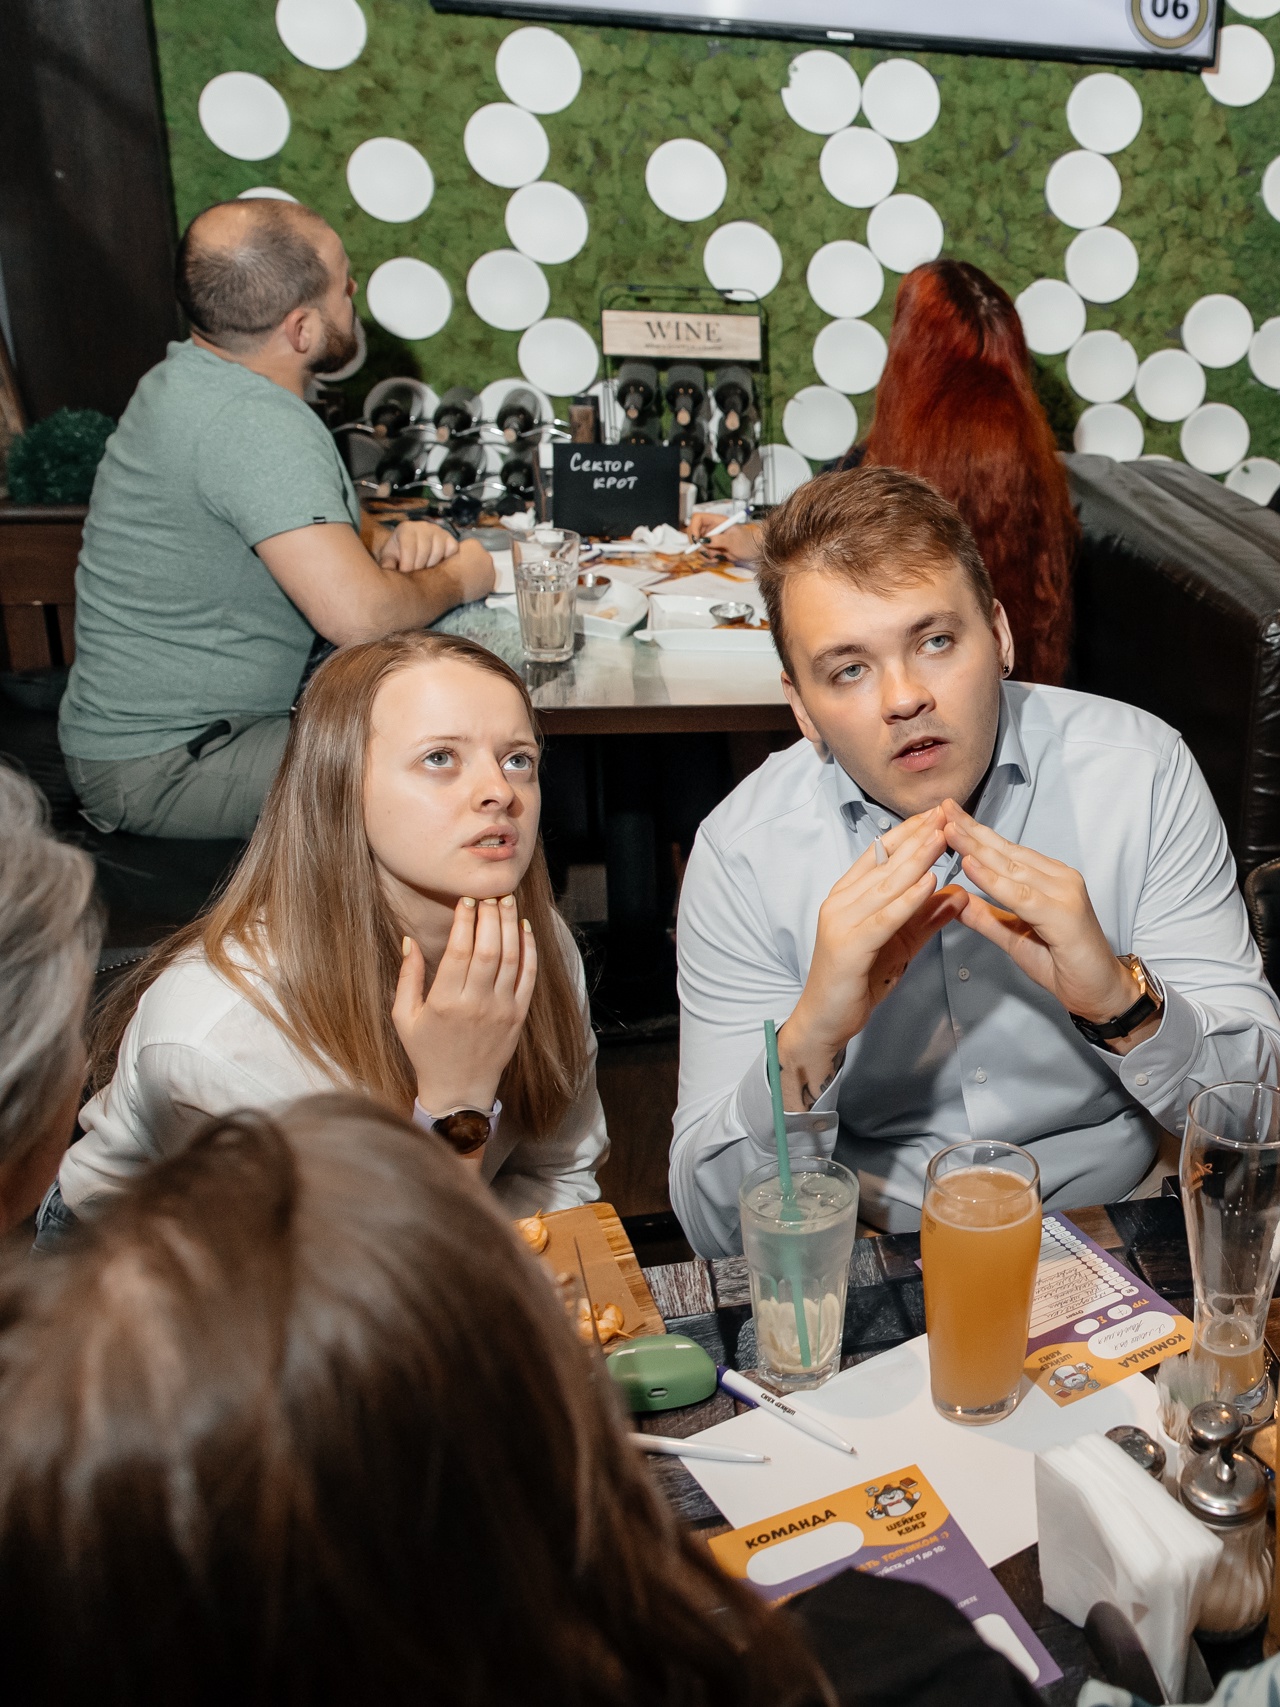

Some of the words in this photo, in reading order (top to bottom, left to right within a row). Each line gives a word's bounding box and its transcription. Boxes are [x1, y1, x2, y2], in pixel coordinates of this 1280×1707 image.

[1151, 0, 1189, 19] 06
[645, 321, 722, 343] WINE
[1132, 1298, 1150, 1309] ТУР
[1038, 1350, 1062, 1364] КВИЗ
[1117, 1333, 1186, 1369] КОМАНДА
[1039, 1353, 1073, 1372] ШЕЙКЕР
[744, 1509, 838, 1550] КОМАНДА
[886, 1511, 928, 1532] ШЕЙКЕР
[897, 1520, 927, 1537] КВИЗ
